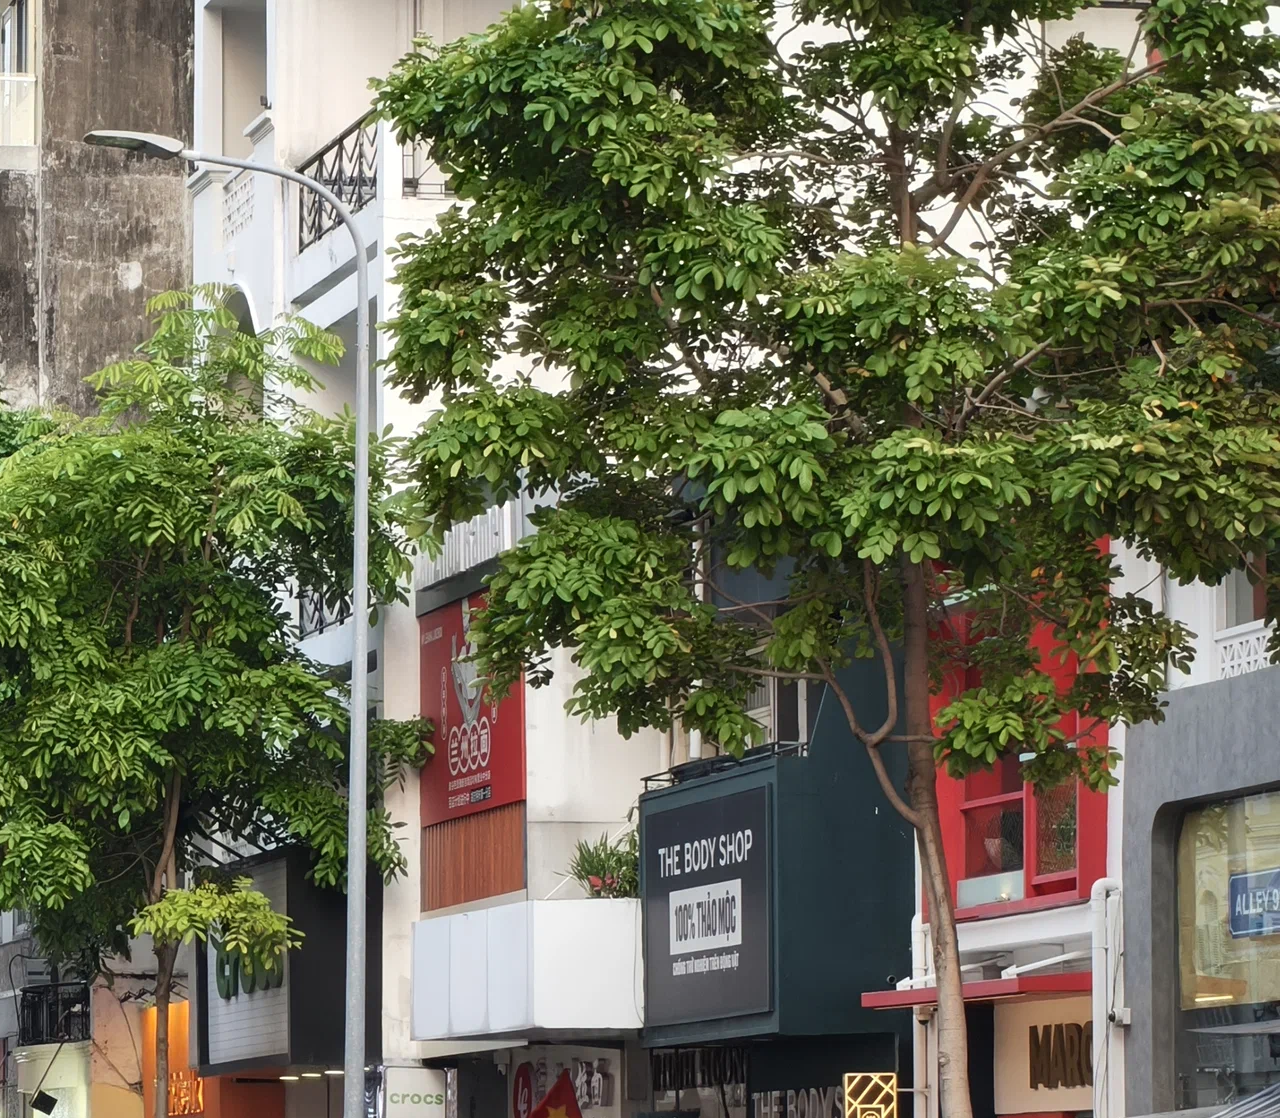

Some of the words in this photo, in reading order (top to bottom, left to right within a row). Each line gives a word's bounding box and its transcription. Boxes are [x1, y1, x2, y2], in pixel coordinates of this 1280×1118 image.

[658, 845, 681, 878] THE
[684, 837, 716, 873] BODY
[719, 829, 753, 866] SHOP
[674, 903, 695, 942] 100%
[696, 892, 717, 938] THẢO
[718, 890, 736, 941] MỘC
[1235, 890, 1270, 916] ALLEY
[389, 1093, 444, 1105] crocs
